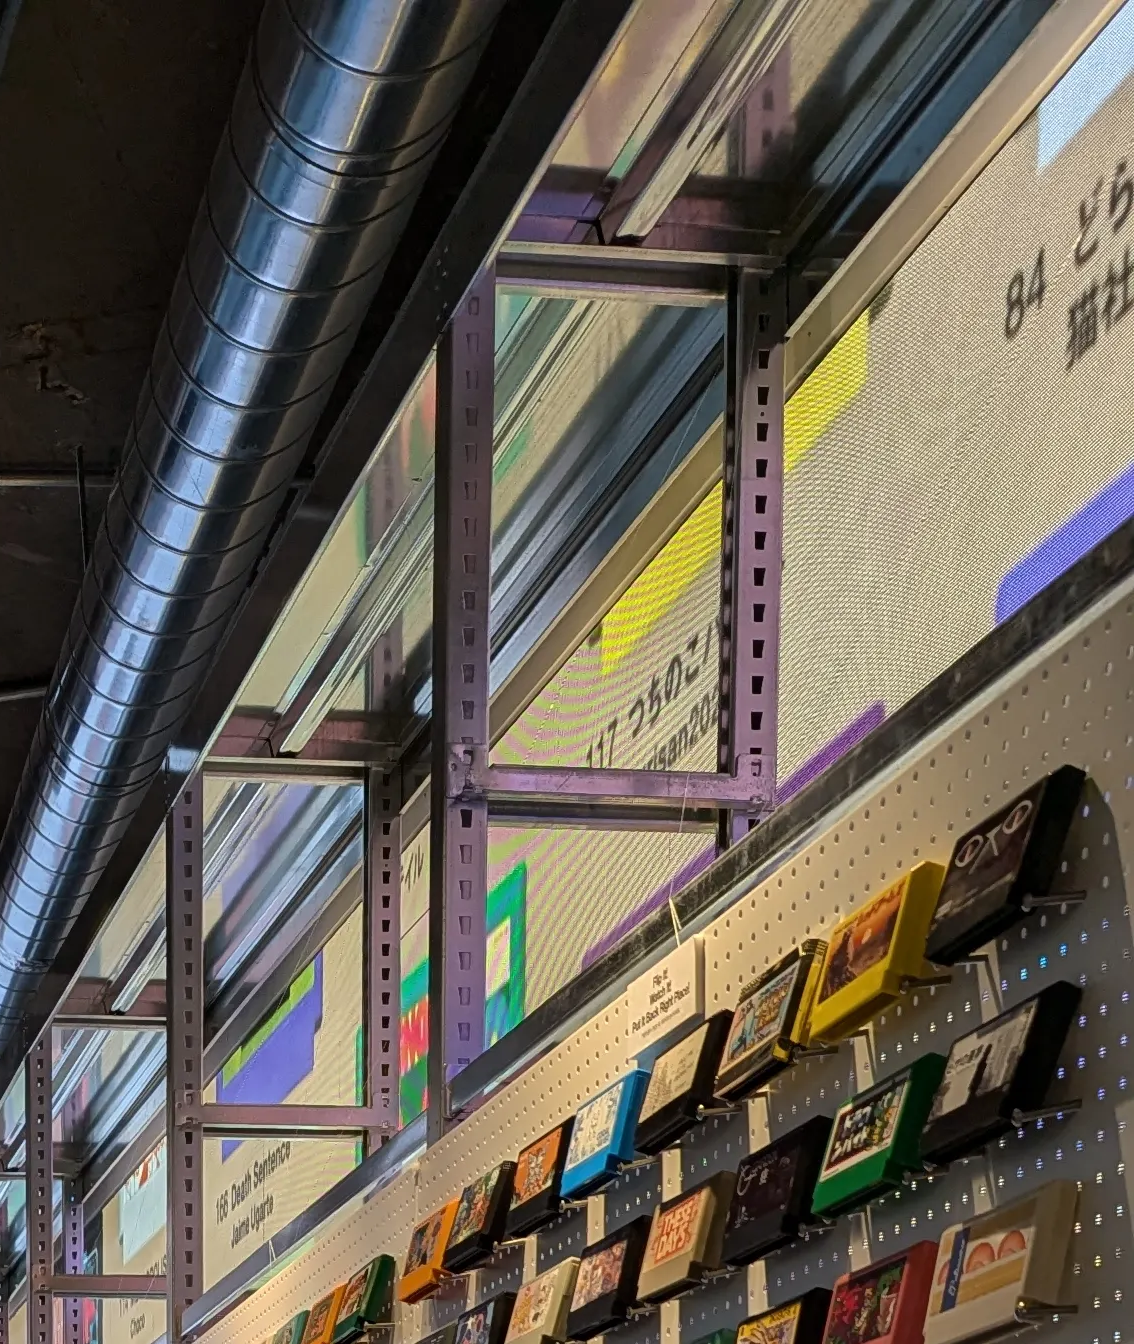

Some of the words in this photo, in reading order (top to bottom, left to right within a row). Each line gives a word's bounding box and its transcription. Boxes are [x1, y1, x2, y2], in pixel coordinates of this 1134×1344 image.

[1004, 245, 1046, 340] 84
[230, 1176, 253, 1212] Death
[253, 1140, 292, 1186] Sentence
[250, 1194, 274, 1233] Ugarte
[656, 1222, 687, 1261] DAYS
